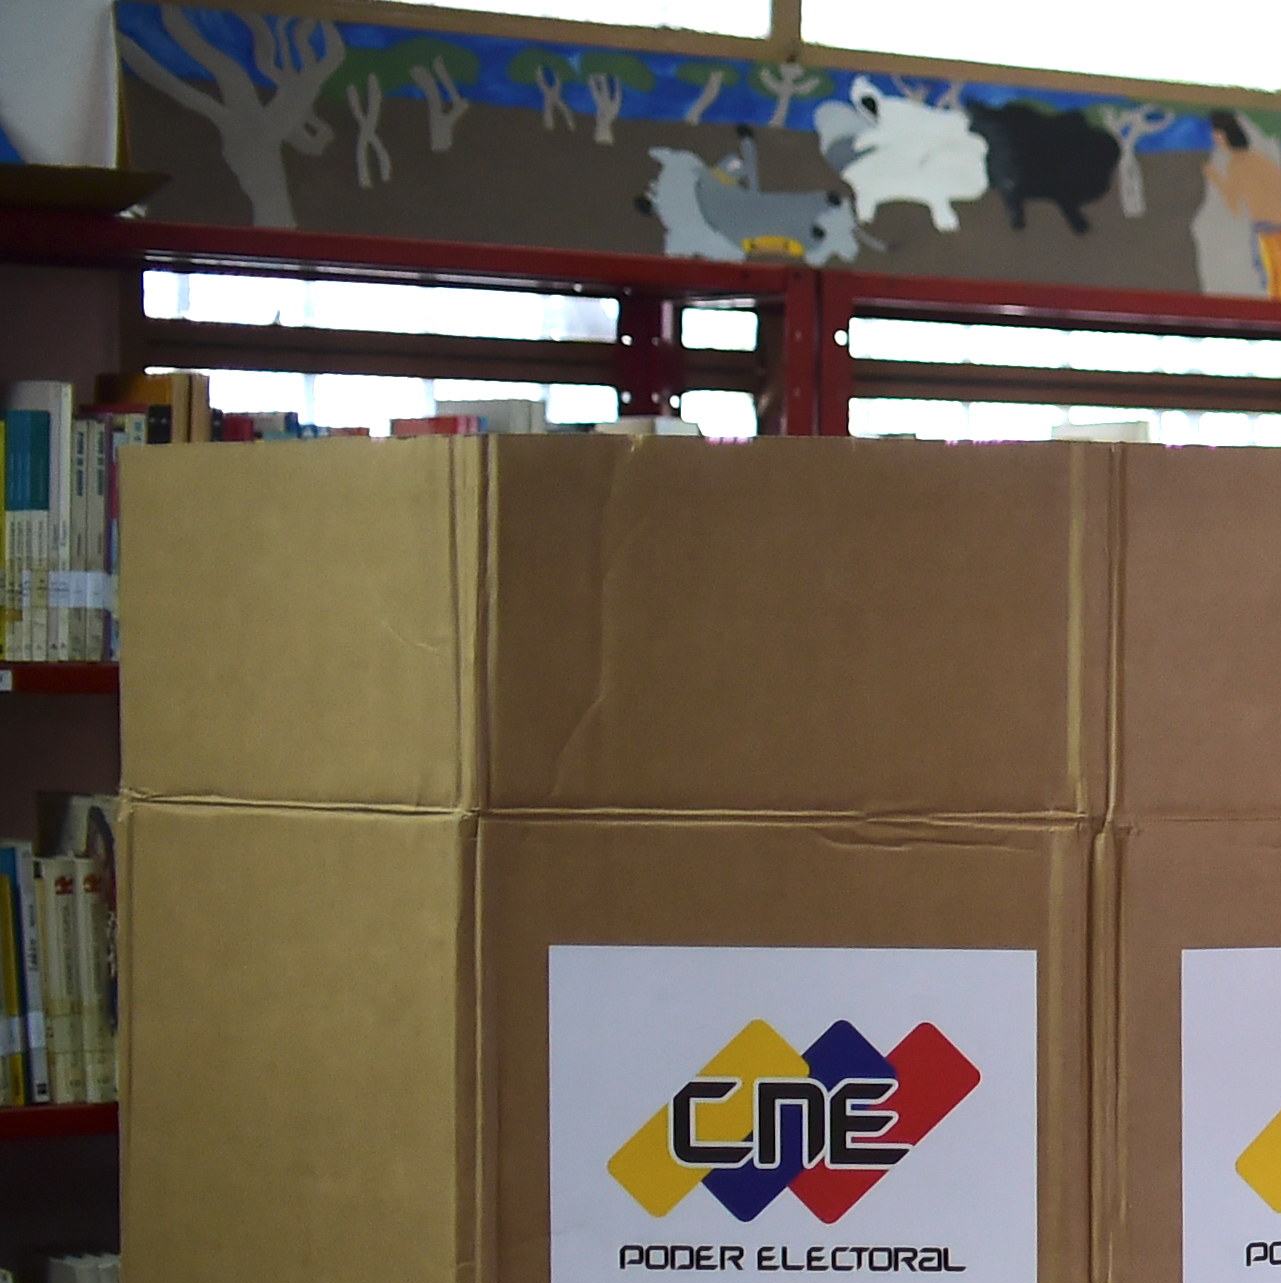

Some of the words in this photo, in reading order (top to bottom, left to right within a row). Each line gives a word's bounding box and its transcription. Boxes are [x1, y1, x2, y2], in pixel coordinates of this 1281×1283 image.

[671, 1079, 911, 1166] CNE
[619, 1245, 744, 1271] PODER
[757, 1246, 968, 1273] ELECTORAL
